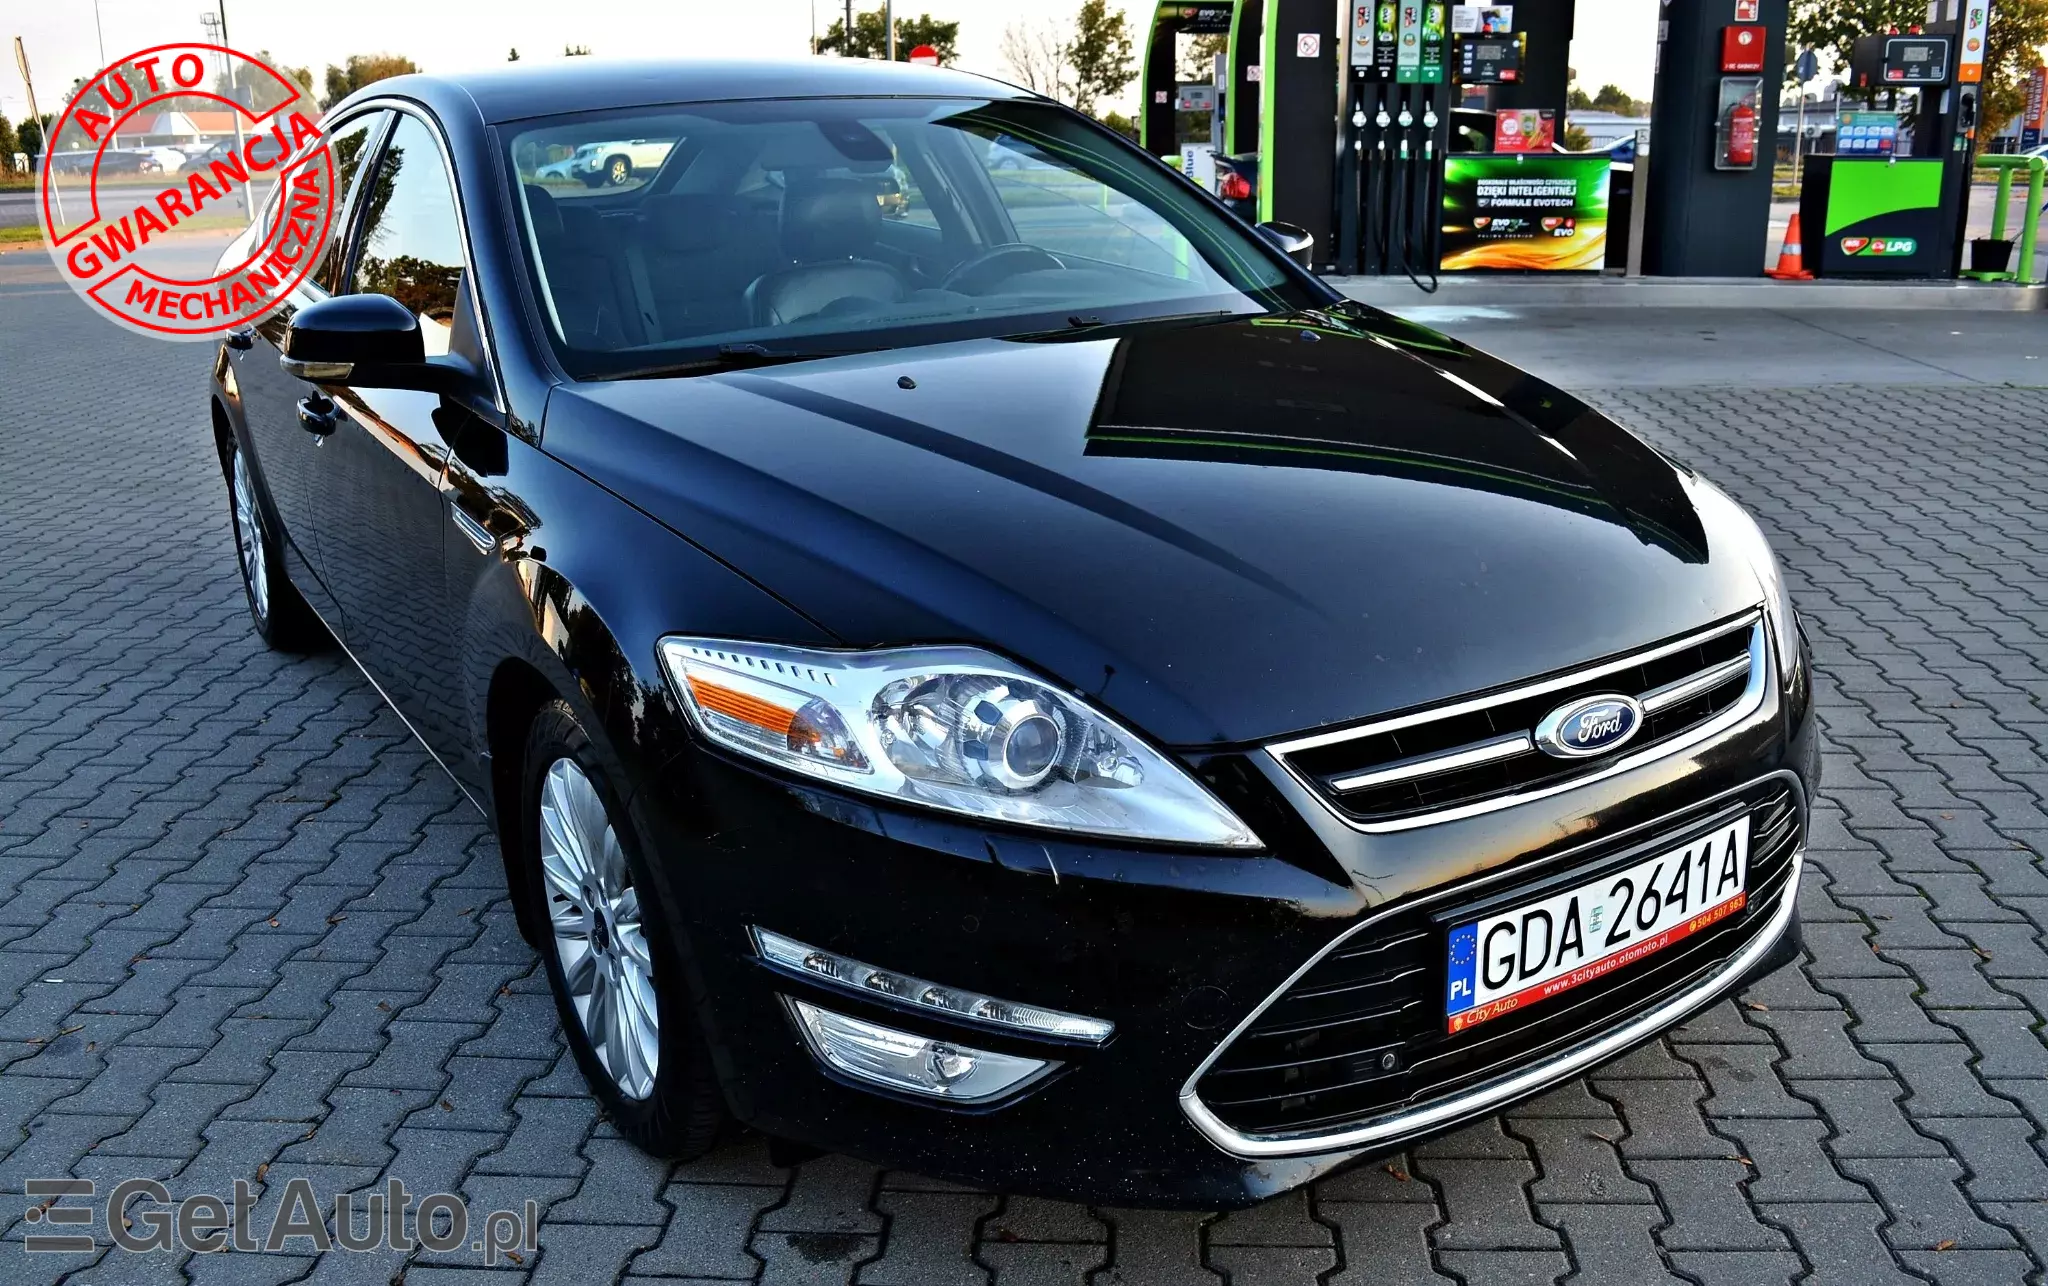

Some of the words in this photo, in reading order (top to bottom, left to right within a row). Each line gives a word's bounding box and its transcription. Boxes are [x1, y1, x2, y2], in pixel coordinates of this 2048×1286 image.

[1477, 186, 1506, 198] DZIĘKI
[1508, 186, 1577, 196] INTELIGENTNEJ
[1554, 228, 1574, 236] EVO
[1886, 241, 1912, 252] LPG
[1578, 708, 1622, 743] Ford
[1482, 896, 1584, 990] GDA
[1604, 830, 1739, 948] 2641A
[1697, 913, 1711, 928] 504
[1714, 905, 1727, 919] 507
[1543, 934, 1668, 995] www.3cityauto.otomoto.pl
[1450, 978, 1471, 1000] PL
[1467, 1008, 1490, 1023] City
[1492, 998, 1518, 1015] Auto
